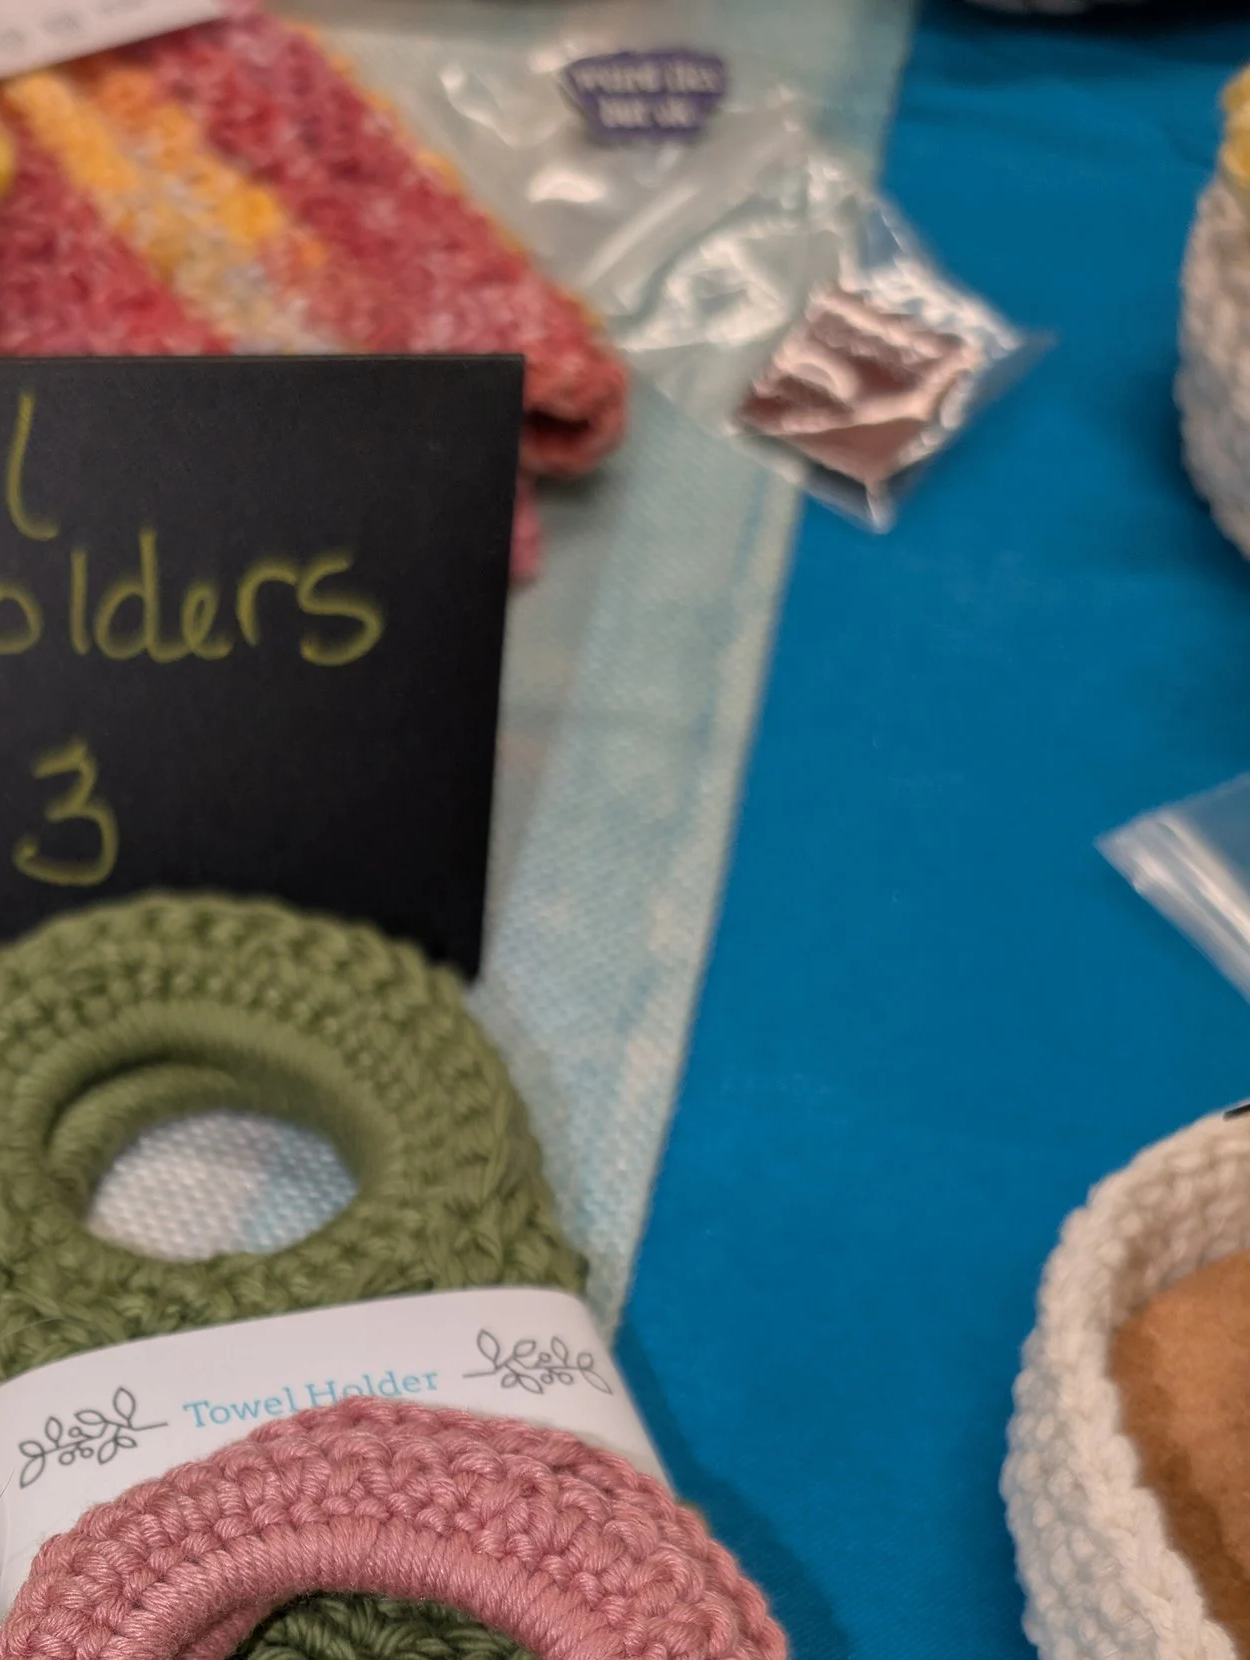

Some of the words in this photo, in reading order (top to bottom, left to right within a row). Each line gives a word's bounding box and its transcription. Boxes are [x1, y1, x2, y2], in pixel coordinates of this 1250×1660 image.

[13, 739, 119, 886] 3
[183, 1386, 298, 1428] Towel
[304, 1370, 438, 1408] Holder
